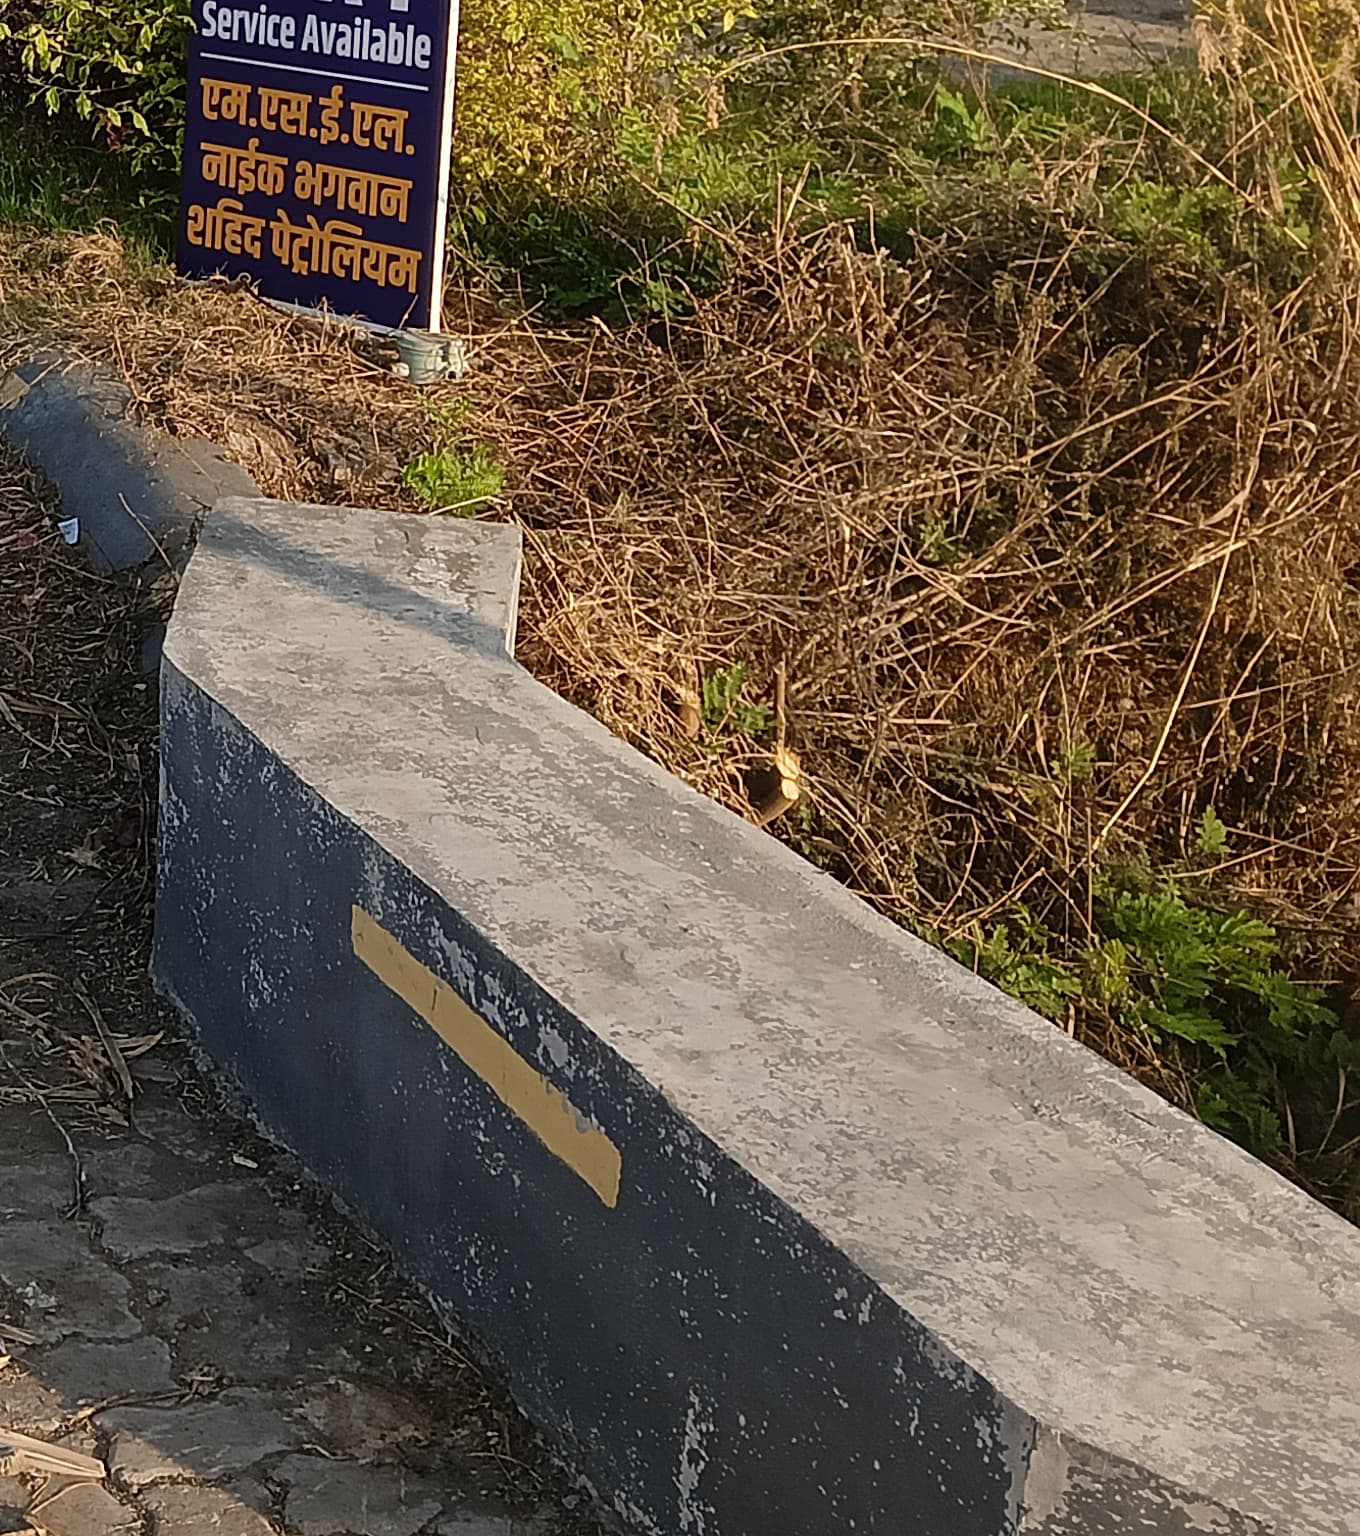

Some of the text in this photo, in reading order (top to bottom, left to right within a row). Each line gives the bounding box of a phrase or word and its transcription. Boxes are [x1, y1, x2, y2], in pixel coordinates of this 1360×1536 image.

[201, 0, 431, 69] Service Available
[200, 77, 415, 155] एम.एस.ई.एल.
[200, 138, 413, 223] नाईक भगवान
[187, 198, 422, 293] शहिद पेट्रोलियम
